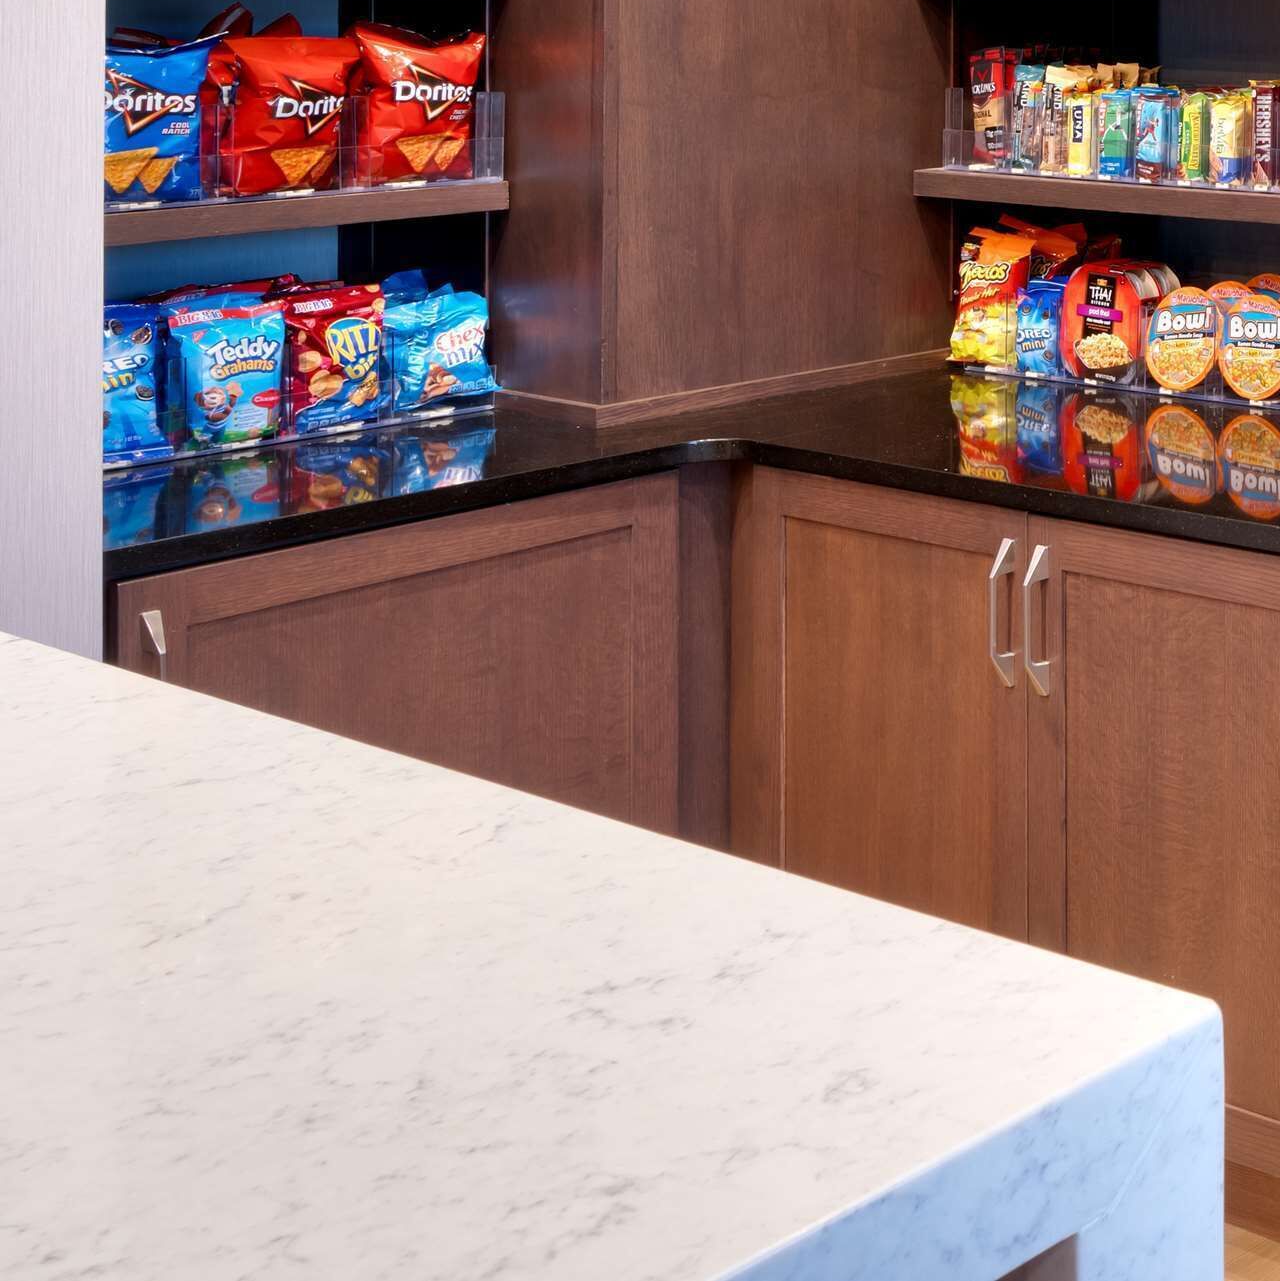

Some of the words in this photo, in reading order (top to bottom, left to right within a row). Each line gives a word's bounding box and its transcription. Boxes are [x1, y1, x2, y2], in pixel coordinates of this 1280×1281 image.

[1073, 106, 1084, 142] UNA
[1157, 307, 1211, 333] Bowl
[206, 336, 281, 366] Teddy
[327, 322, 379, 365] RITZ
[437, 325, 484, 352] Chex
